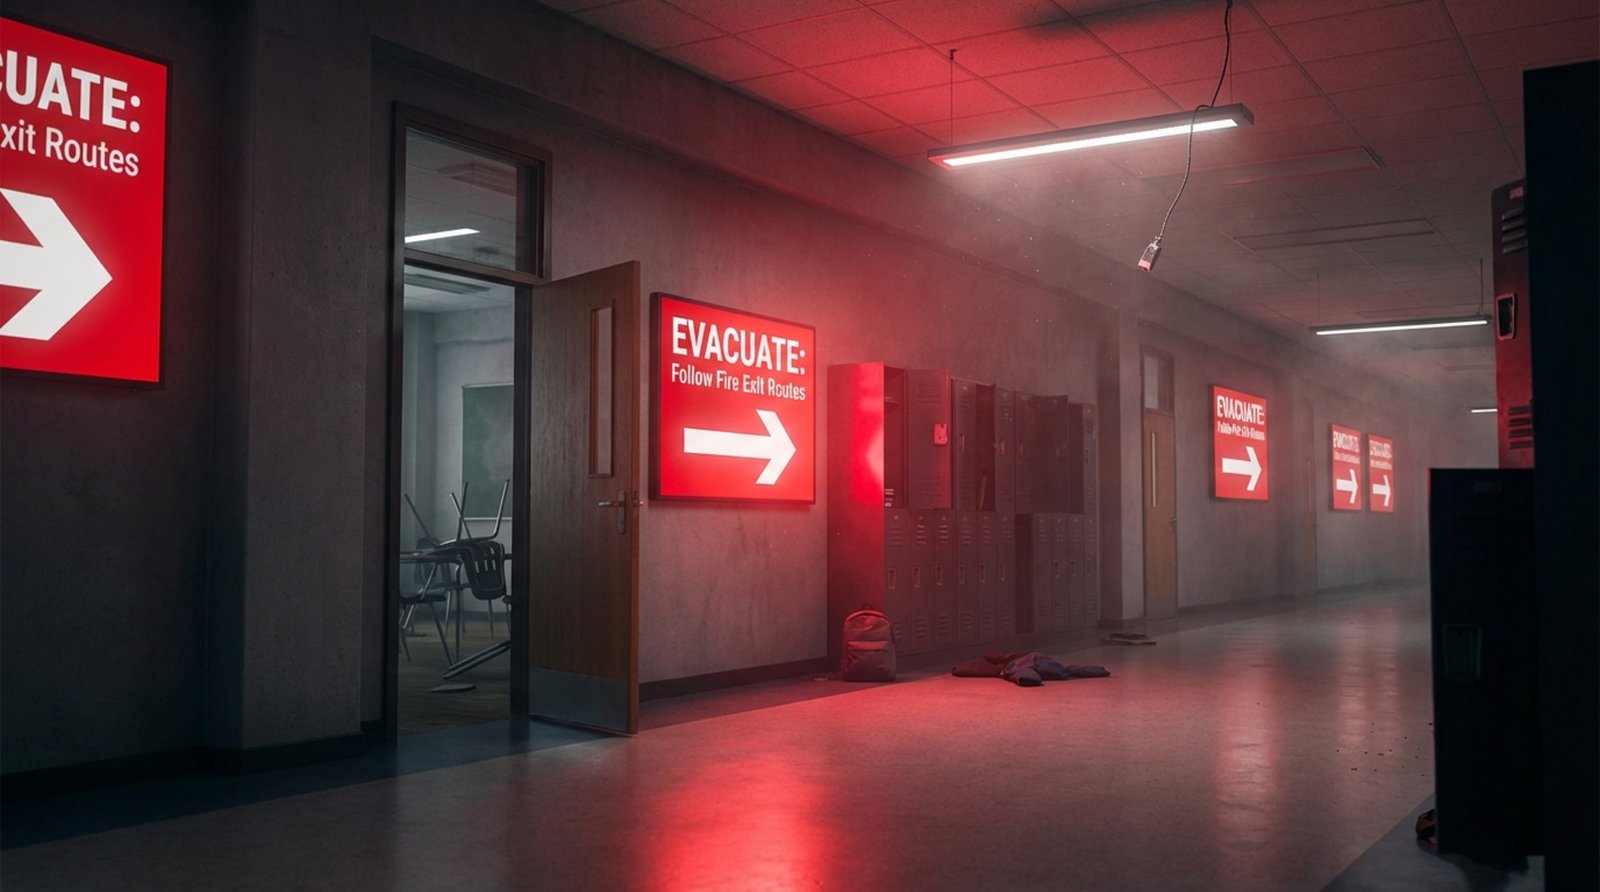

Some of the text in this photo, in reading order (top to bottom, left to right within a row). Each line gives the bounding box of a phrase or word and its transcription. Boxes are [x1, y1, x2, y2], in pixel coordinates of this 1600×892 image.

[0, 49, 141, 133] UATE:
[45, 127, 139, 177] Routes
[672, 316, 805, 375] EVACUATE:
[671, 363, 713, 387] Follow
[716, 370, 739, 392] Fire
